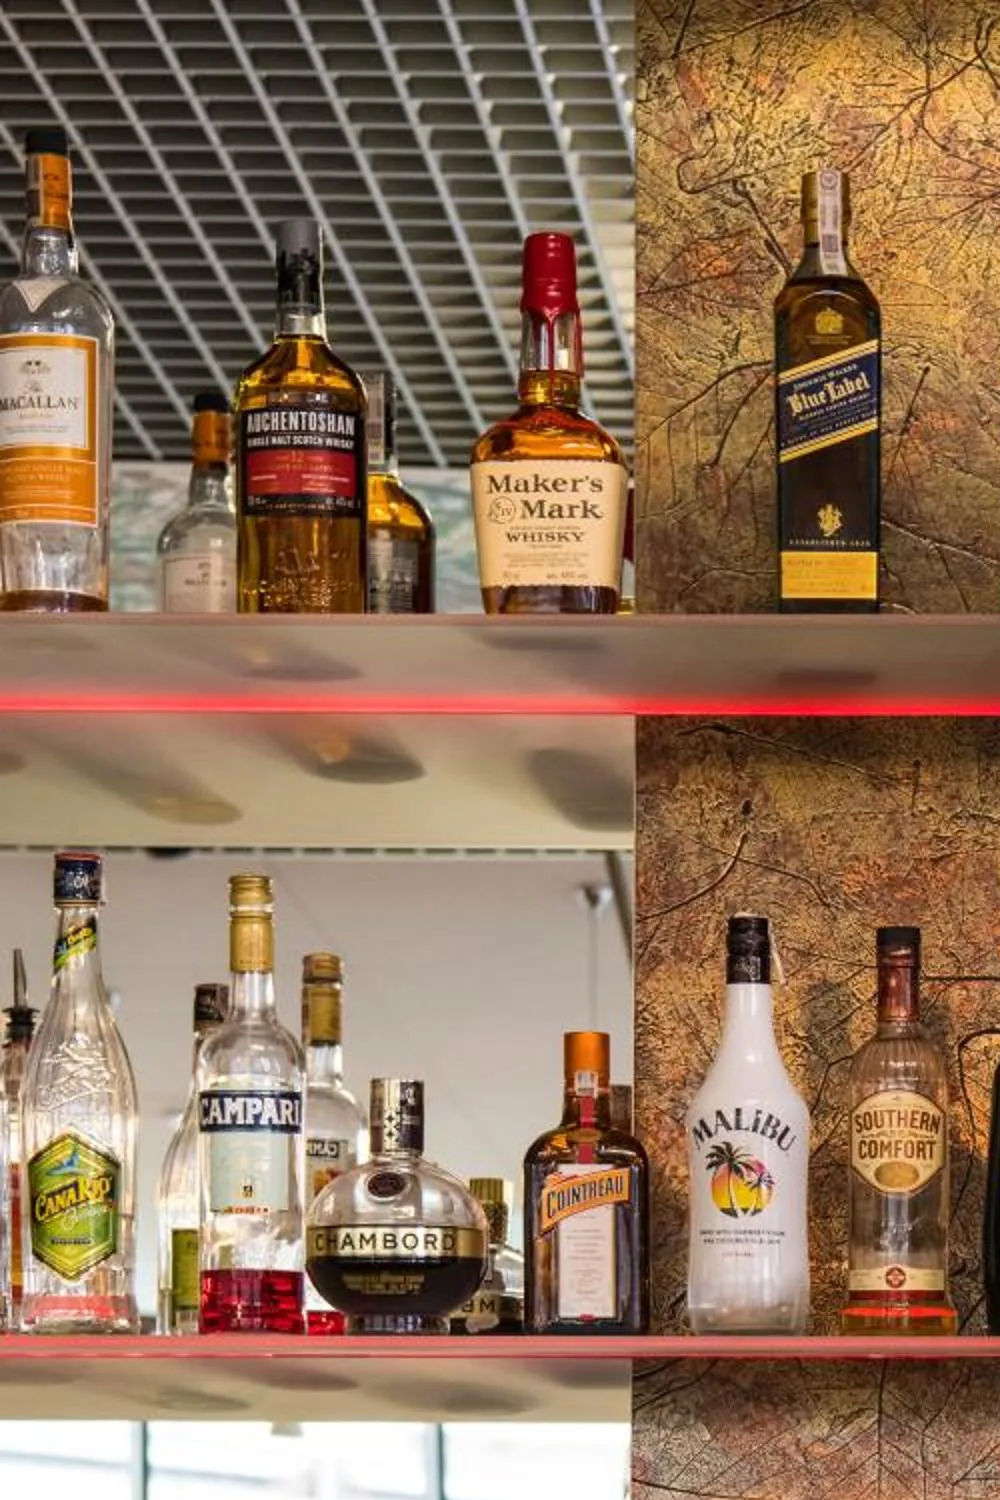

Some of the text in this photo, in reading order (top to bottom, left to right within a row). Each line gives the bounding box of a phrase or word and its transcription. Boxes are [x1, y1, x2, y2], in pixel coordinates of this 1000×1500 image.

[787, 371, 870, 417] Blue Label
[247, 411, 355, 436] AUCHENTOSHAN
[487, 474, 604, 494] Maker's
[520, 499, 603, 519] Mark
[505, 531, 586, 544] WHISKY
[202, 1097, 299, 1126] CAMPARI
[855, 1109, 941, 1135] SOUTHERN
[858, 1139, 937, 1161] COMFORT
[547, 1175, 624, 1219] COINTREAU
[315, 1232, 456, 1252] CHAMBORD
